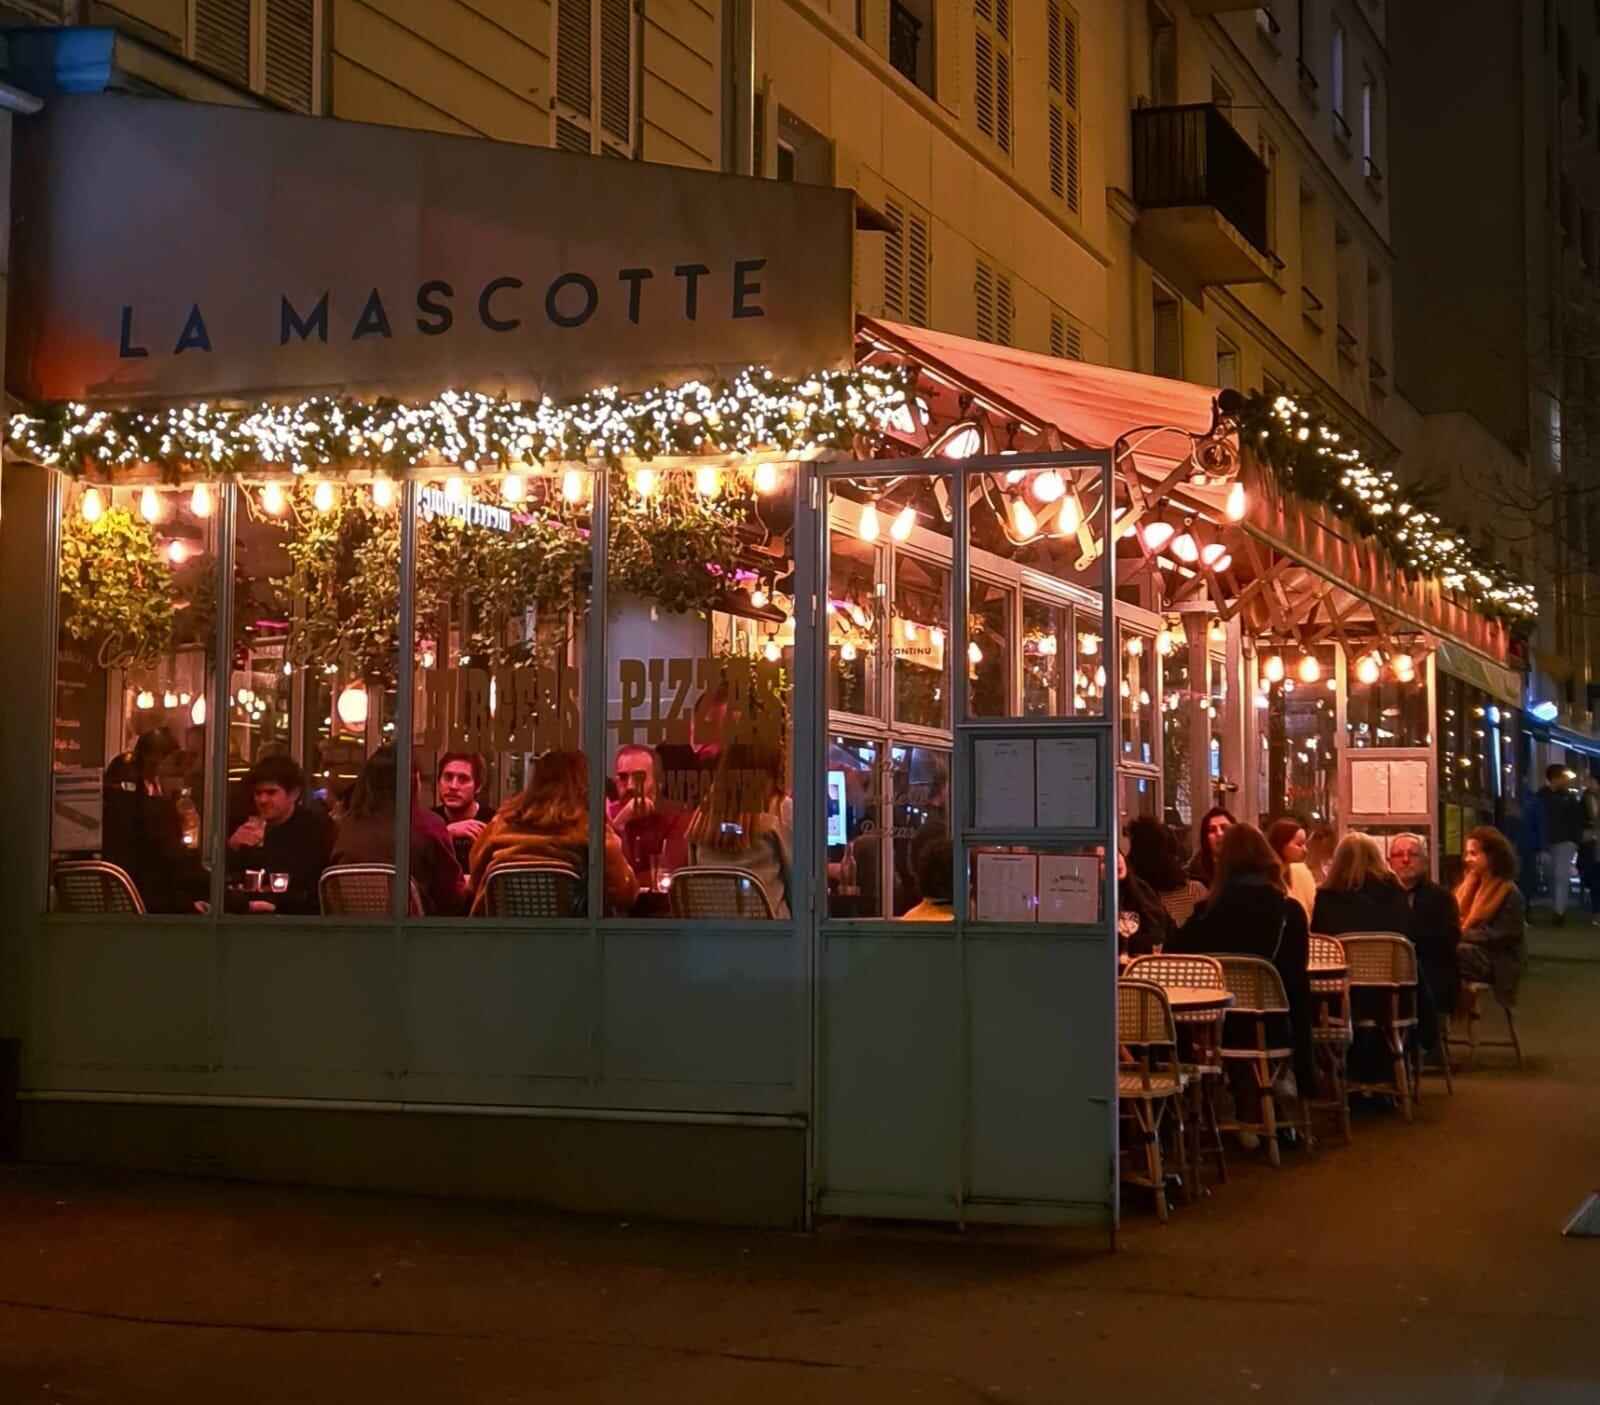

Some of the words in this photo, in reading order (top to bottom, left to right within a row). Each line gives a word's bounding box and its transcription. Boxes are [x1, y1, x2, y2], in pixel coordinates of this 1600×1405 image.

[119, 303, 213, 358] LA
[280, 259, 768, 346] MASCOTTE
[618, 658, 783, 745] PIZZAS
